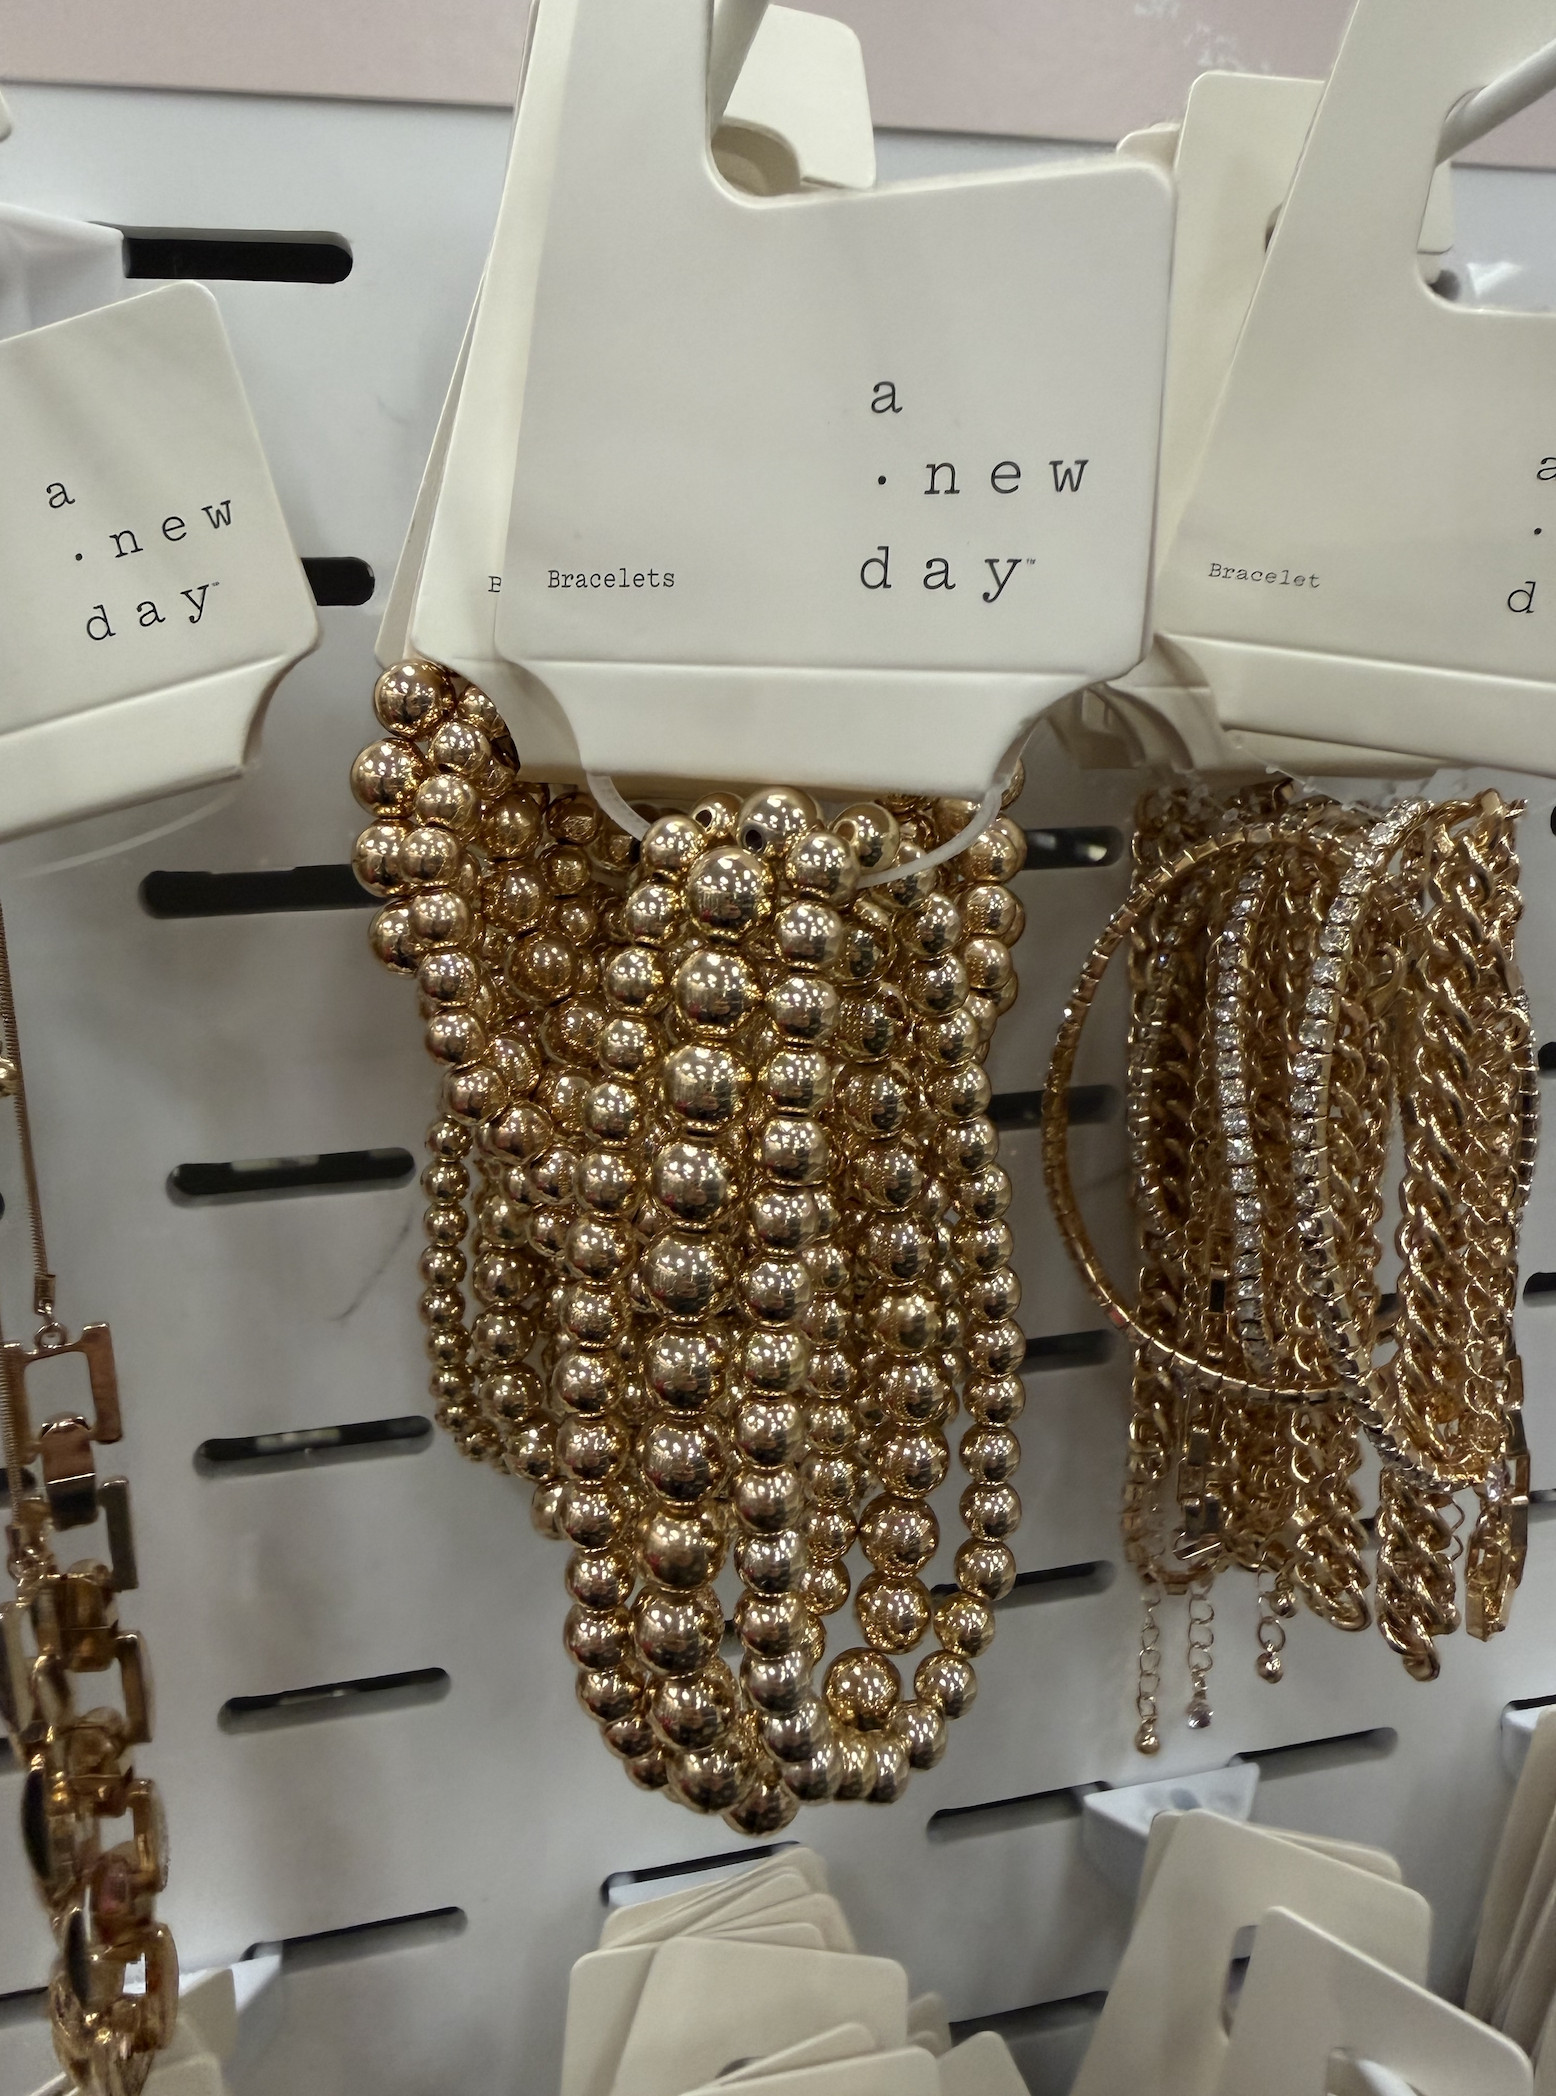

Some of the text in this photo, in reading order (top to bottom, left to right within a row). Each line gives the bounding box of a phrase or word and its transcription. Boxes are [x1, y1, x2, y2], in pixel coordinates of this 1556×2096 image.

[870, 380, 903, 415] a
[45, 482, 76, 510] a
[547, 567, 676, 589] Bracelets
[1207, 562, 1321, 589] Bracelet
